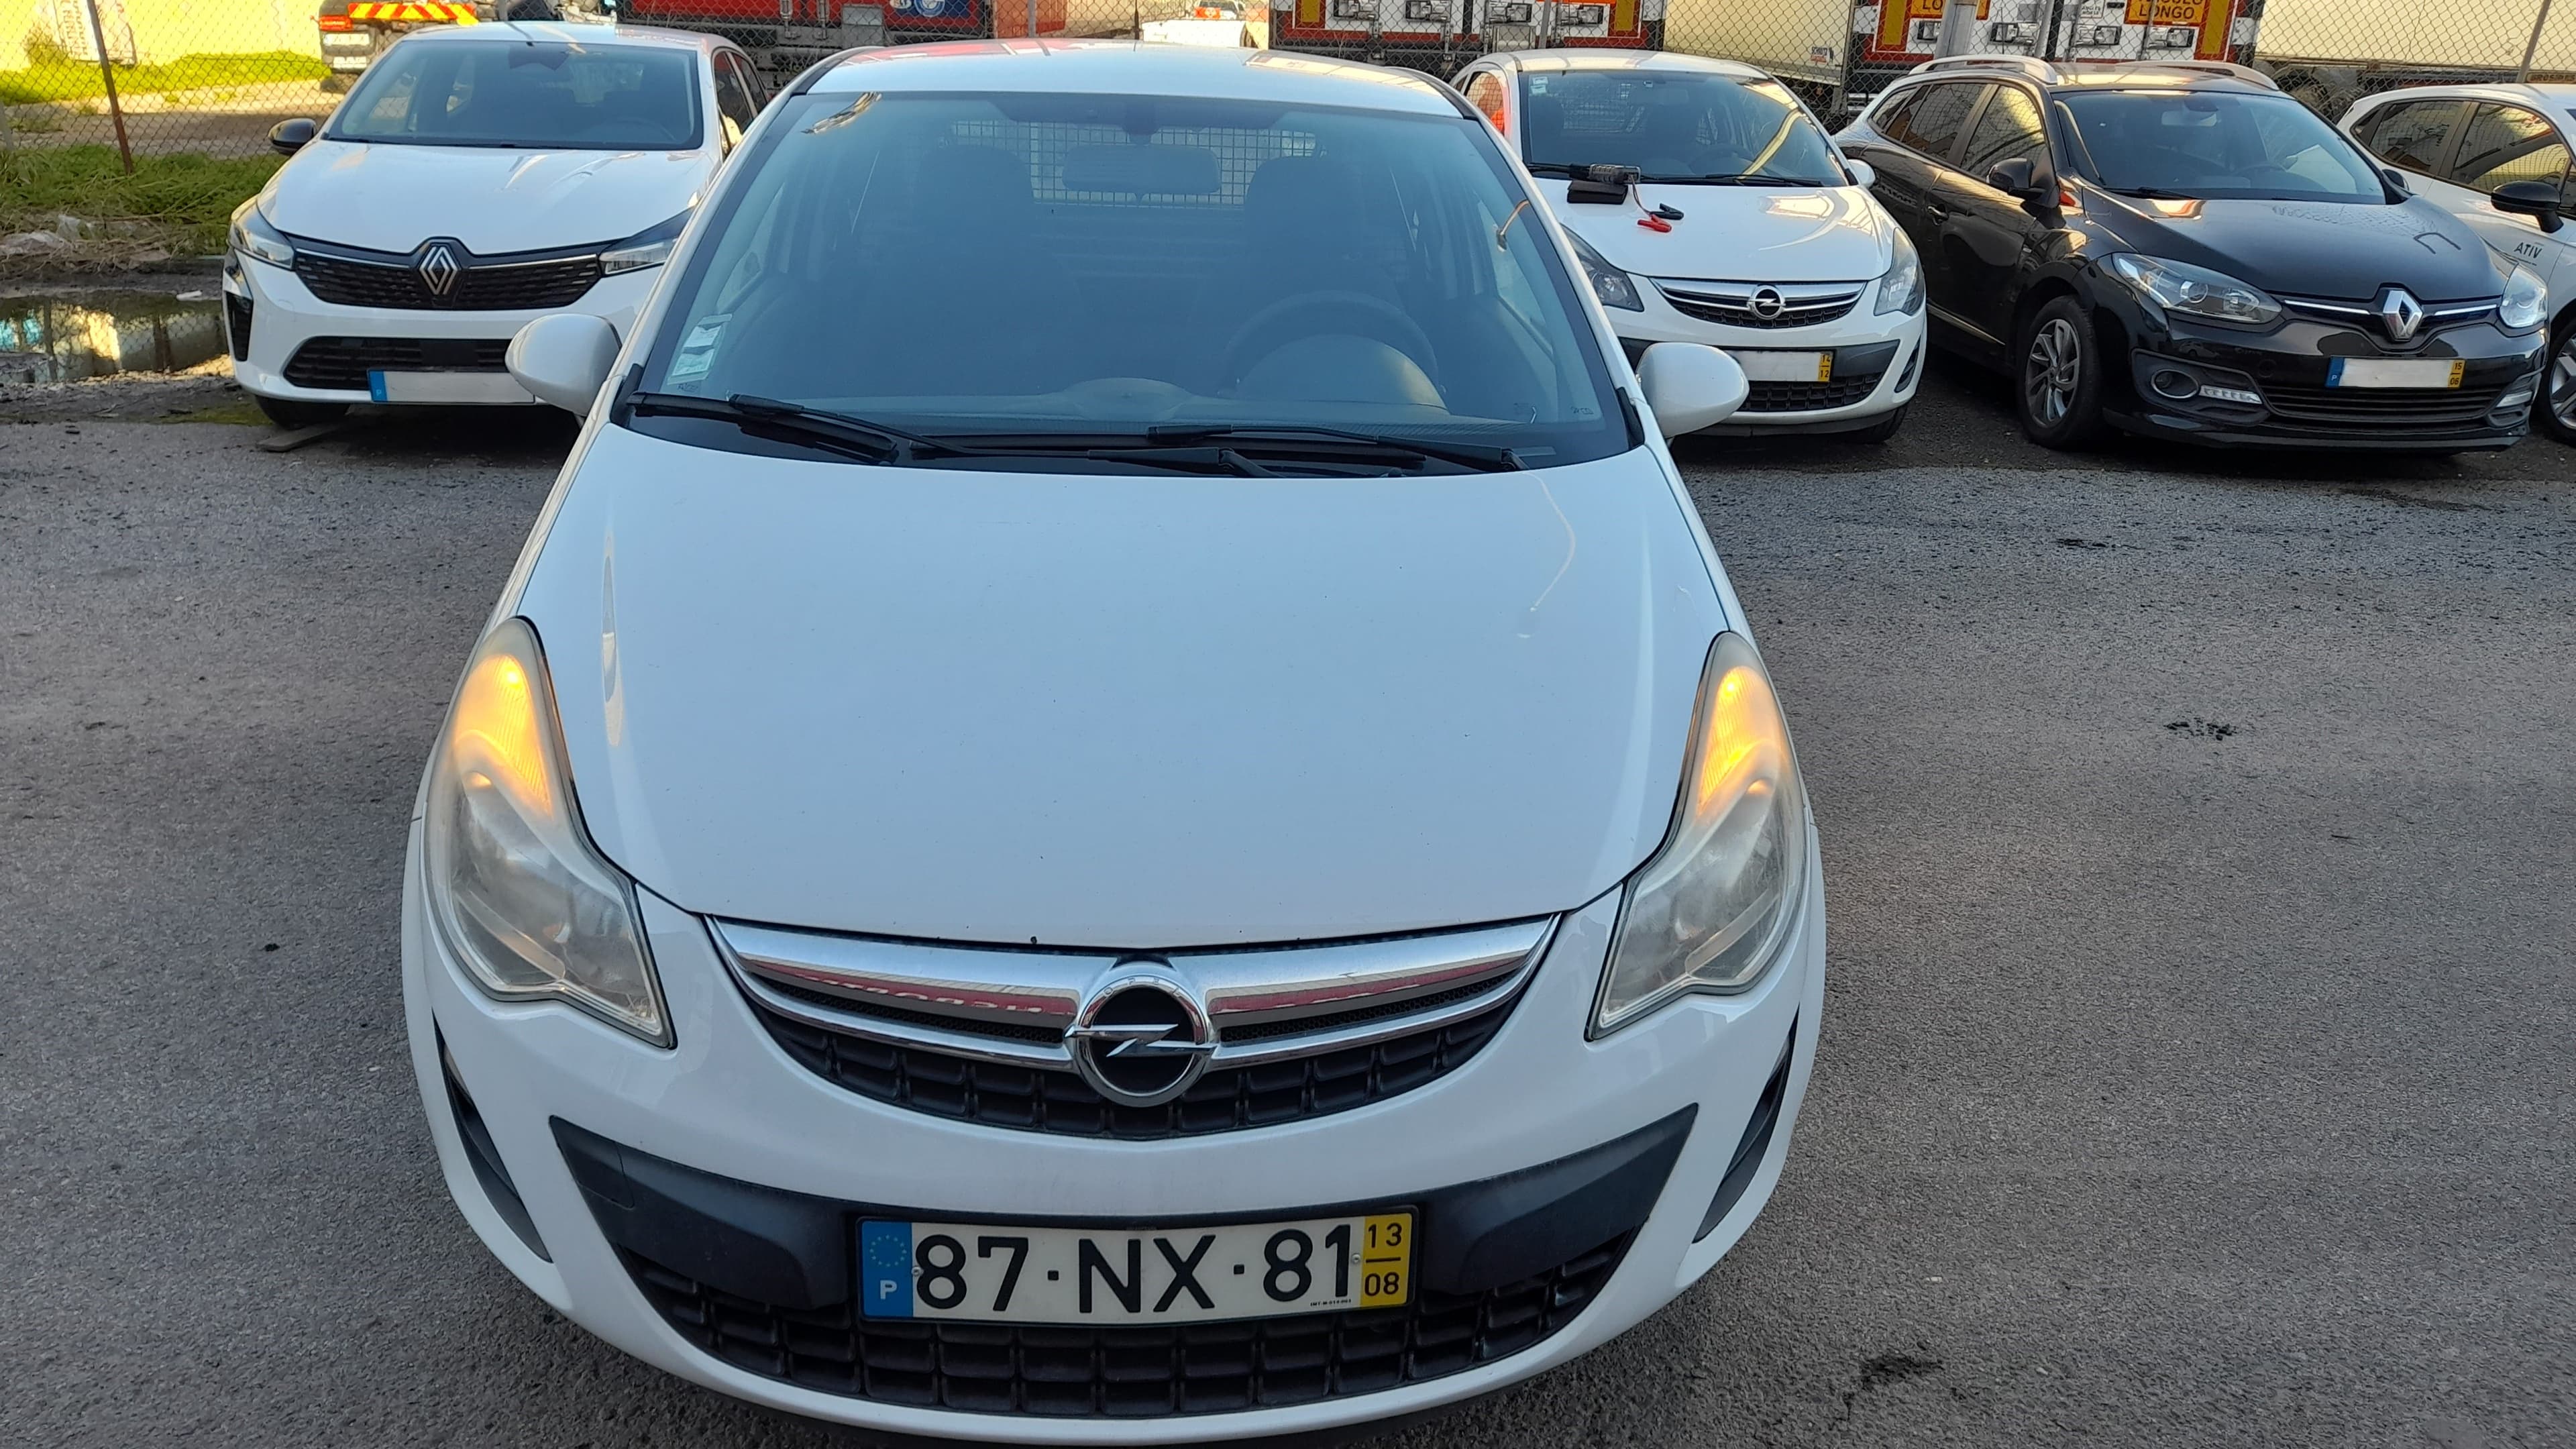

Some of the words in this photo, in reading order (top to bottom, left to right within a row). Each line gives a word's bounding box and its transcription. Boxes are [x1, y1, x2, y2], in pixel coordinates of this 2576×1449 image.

[2139, 4, 2195, 19] LONGO
[2513, 241, 2543, 259] ATIV
[1368, 1222, 1403, 1249] 13
[879, 1279, 898, 1300] P
[1364, 1271, 1400, 1297] 08
